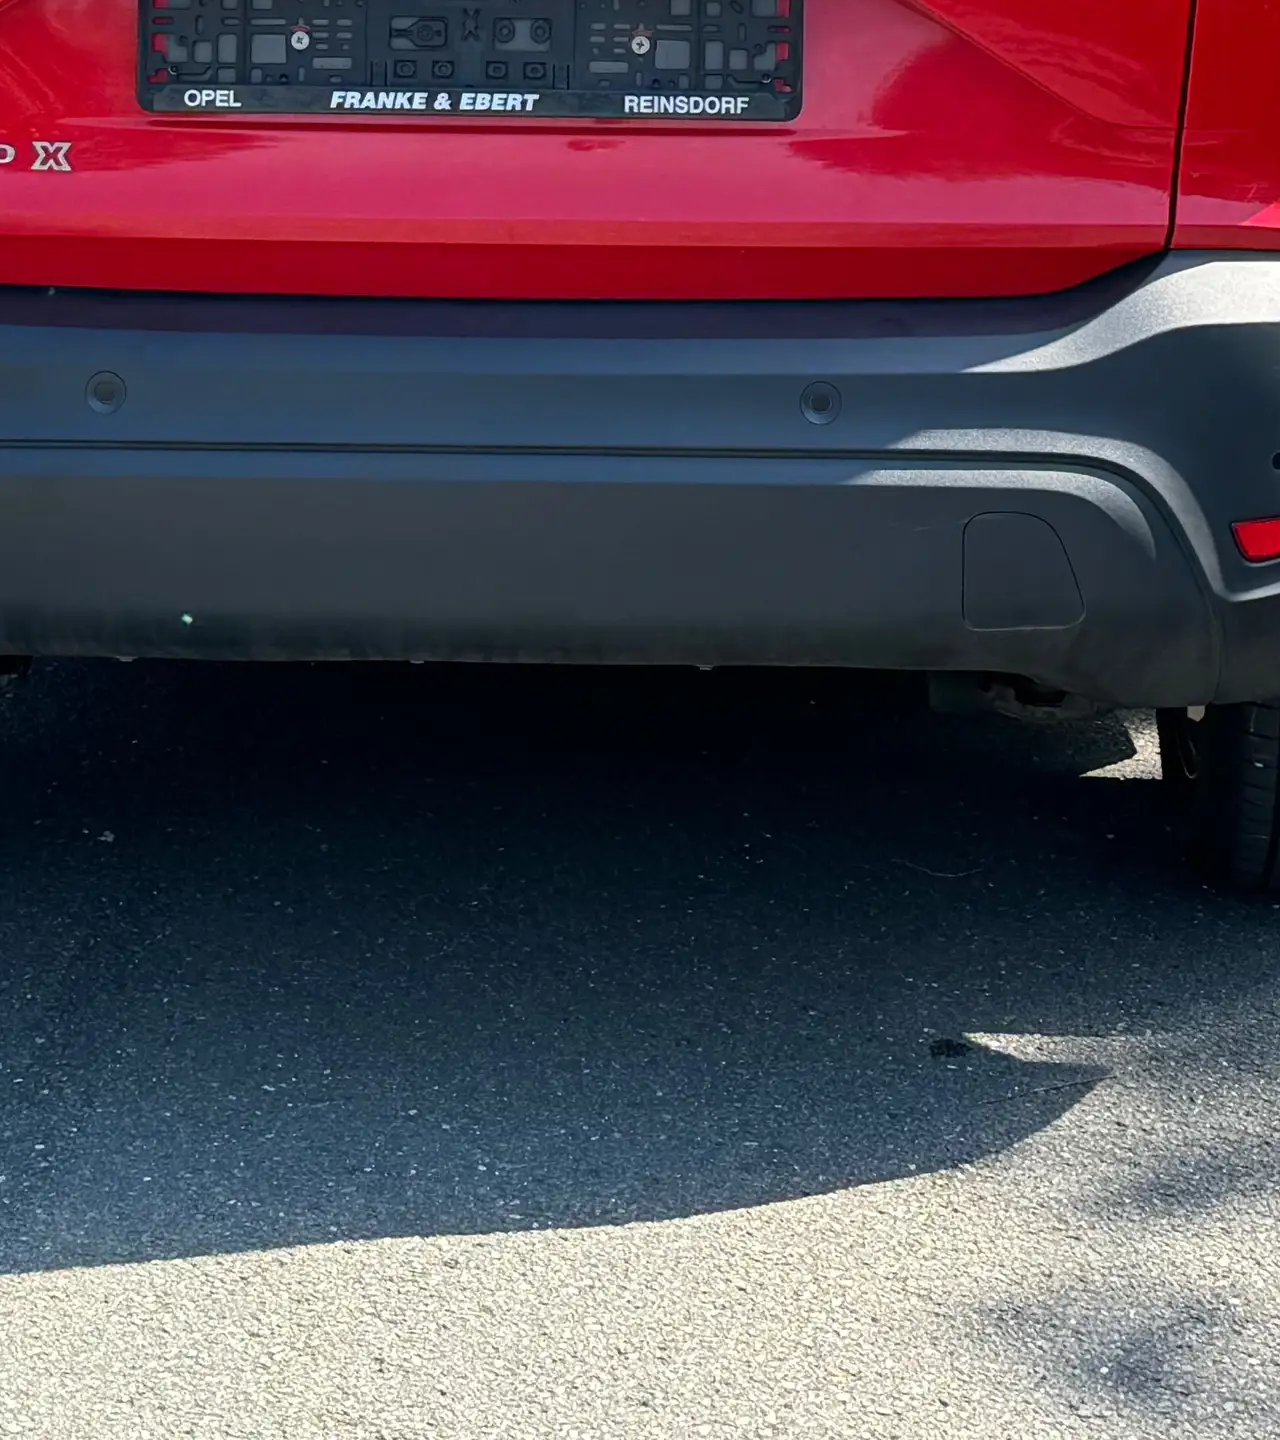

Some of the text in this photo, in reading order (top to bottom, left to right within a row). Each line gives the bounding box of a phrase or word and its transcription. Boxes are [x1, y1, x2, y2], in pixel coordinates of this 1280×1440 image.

[184, 90, 241, 108] OPEL
[330, 91, 539, 111] FRANKE & EBERT
[624, 95, 749, 114] REINSDORF
[30, 141, 72, 171] X
